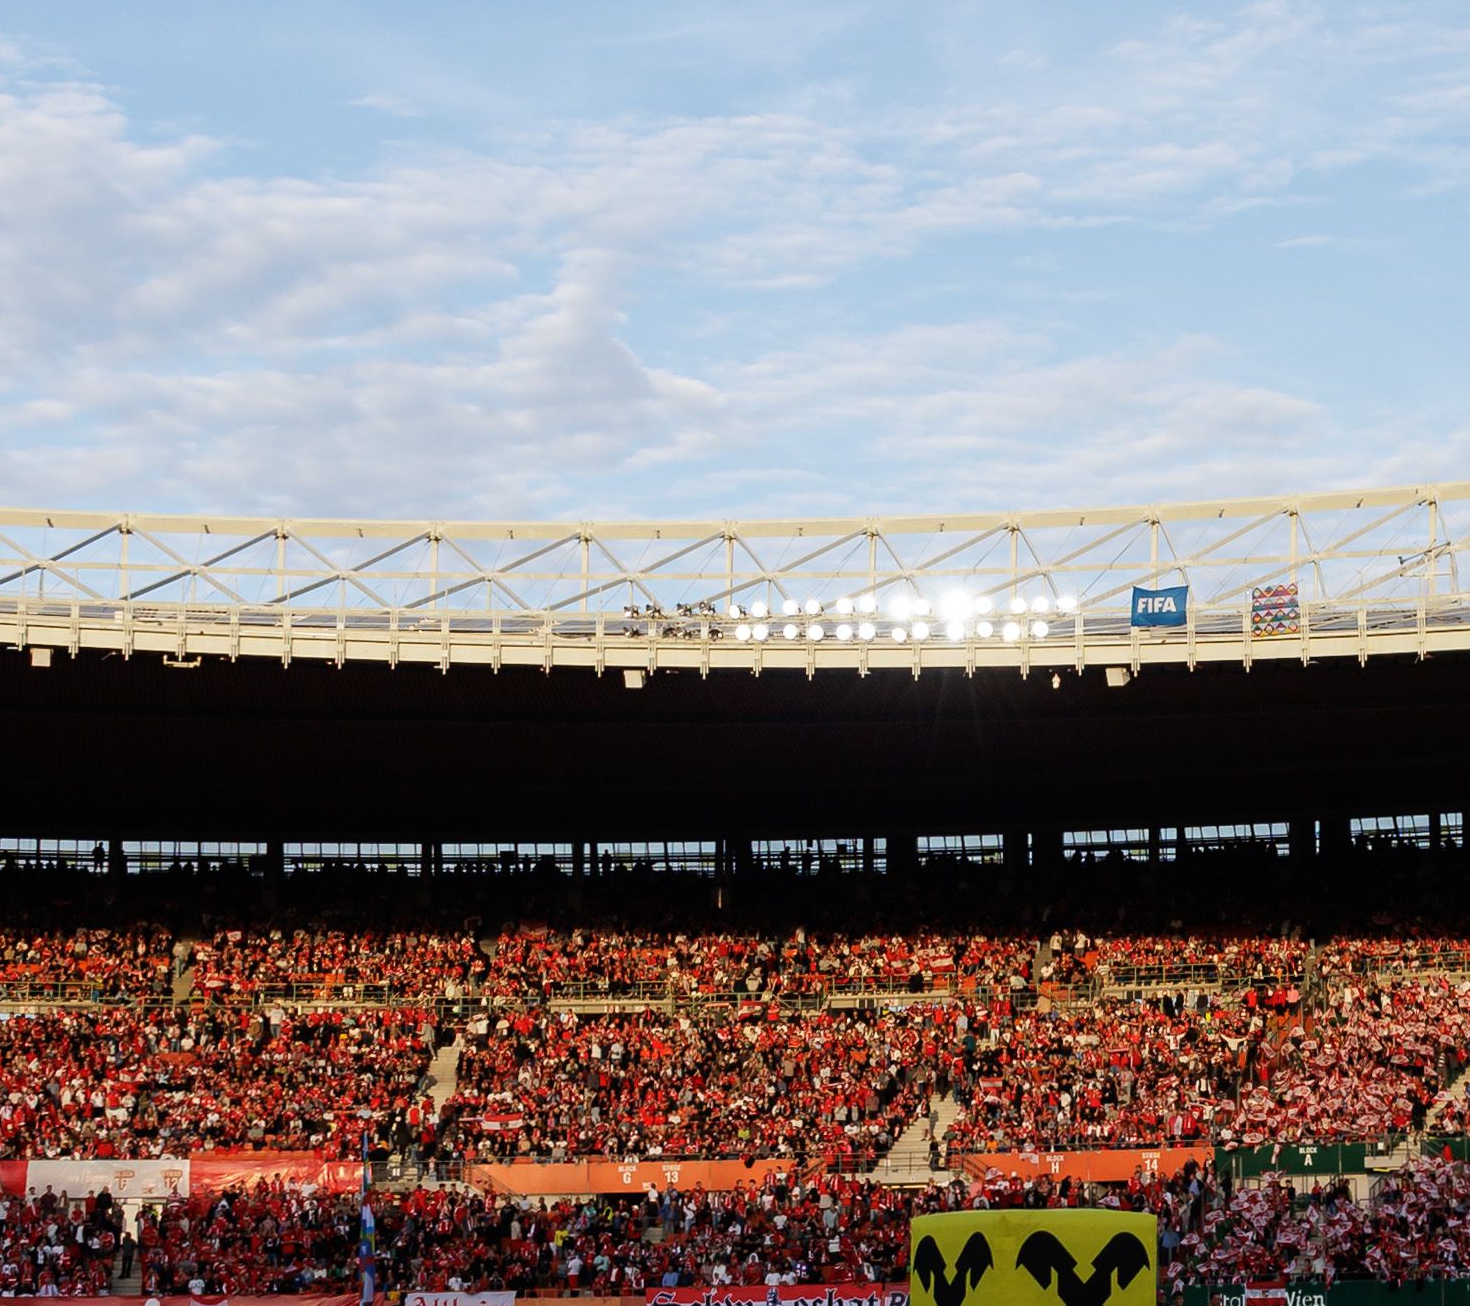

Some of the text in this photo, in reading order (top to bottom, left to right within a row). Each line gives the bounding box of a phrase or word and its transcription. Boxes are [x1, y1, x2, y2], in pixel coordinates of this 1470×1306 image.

[1137, 596, 1177, 613] FIFA
[1299, 1146, 1318, 1154] BLOCK
[1145, 1159, 1159, 1171] 14
[1303, 1154, 1313, 1166] A
[618, 1165, 637, 1173] BLOCK
[1050, 1162, 1060, 1174] H
[664, 1171, 679, 1183] 13
